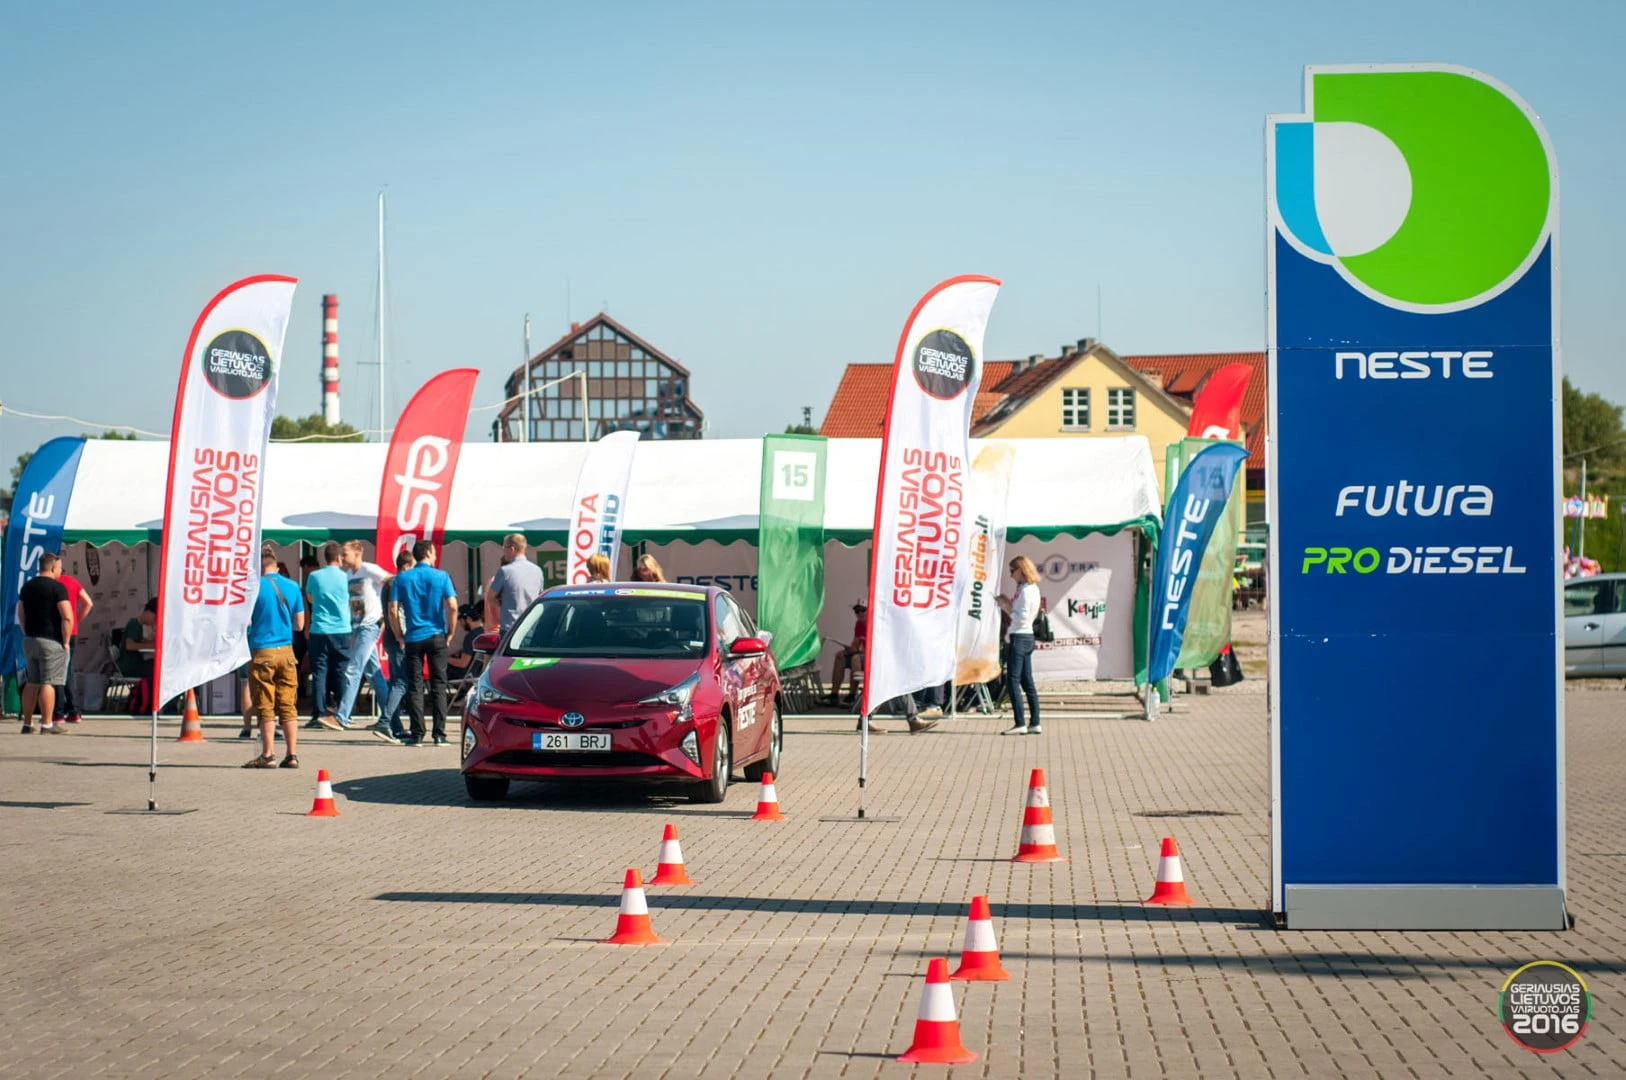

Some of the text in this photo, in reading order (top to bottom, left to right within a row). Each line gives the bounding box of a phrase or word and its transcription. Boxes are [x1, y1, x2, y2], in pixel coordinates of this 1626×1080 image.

[210, 348, 265, 364] GERIAUSIAS
[210, 356, 264, 373] LIETUVOS
[919, 355, 966, 374] LIETUVOS
[920, 347, 968, 365] GERIAUSIAS
[1335, 351, 1494, 380] NESTE
[209, 365, 263, 380] VAIRUOTOJAS
[918, 364, 964, 382] VAIRUOTOJAS
[781, 464, 809, 487] 15
[183, 448, 215, 604] GERIAUSIAS
[204, 451, 240, 606] LIETUVOS
[228, 453, 258, 606] VAIRUOTOJAS
[893, 448, 922, 608] GERIAUSIAS
[913, 451, 947, 608] LIETUVOS
[935, 455, 963, 609] VAIRUOTOJAS
[1162, 494, 1210, 630] NESTE
[1301, 547, 1380, 574] PRO
[546, 735, 569, 748] 261
[580, 735, 607, 749] BRJ
